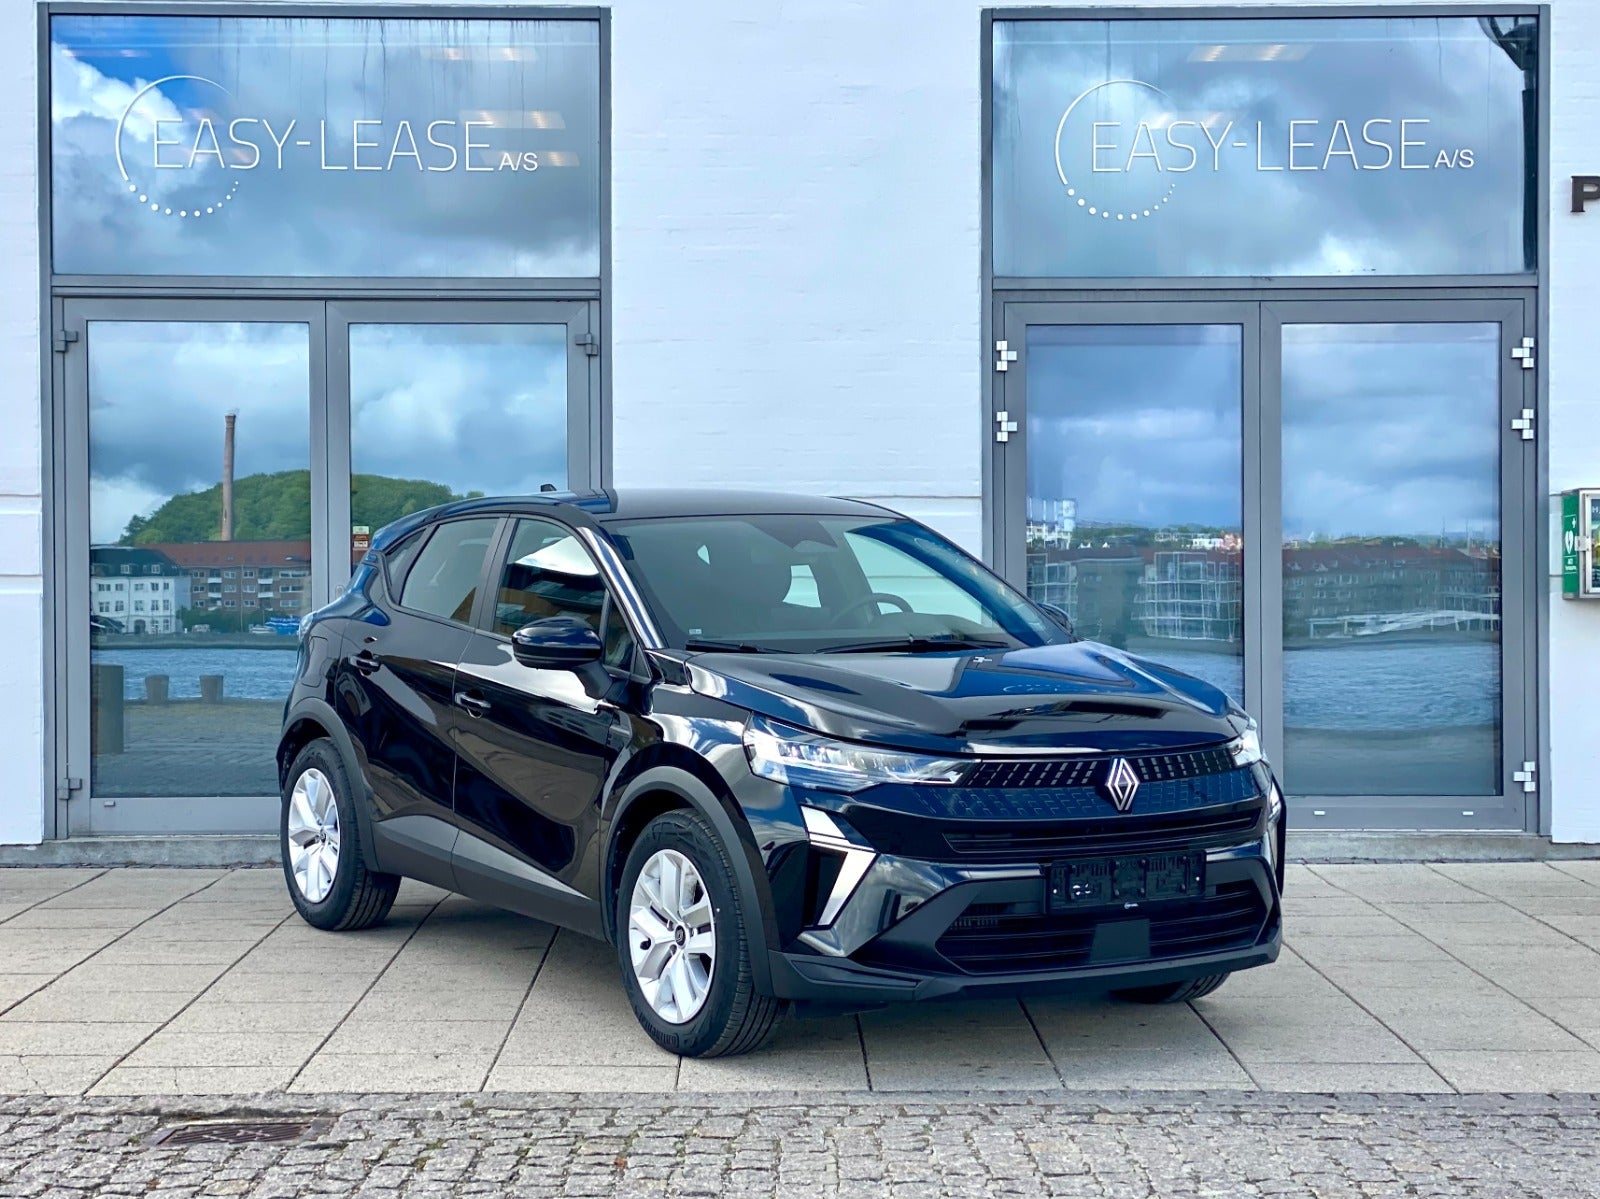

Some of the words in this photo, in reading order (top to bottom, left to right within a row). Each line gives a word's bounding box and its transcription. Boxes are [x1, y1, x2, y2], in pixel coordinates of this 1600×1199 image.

[153, 118, 495, 172] EASY-LEASE
[498, 152, 539, 172] A/S
[1091, 118, 1431, 173] EASY-LEASE
[1434, 148, 1475, 169] A/S
